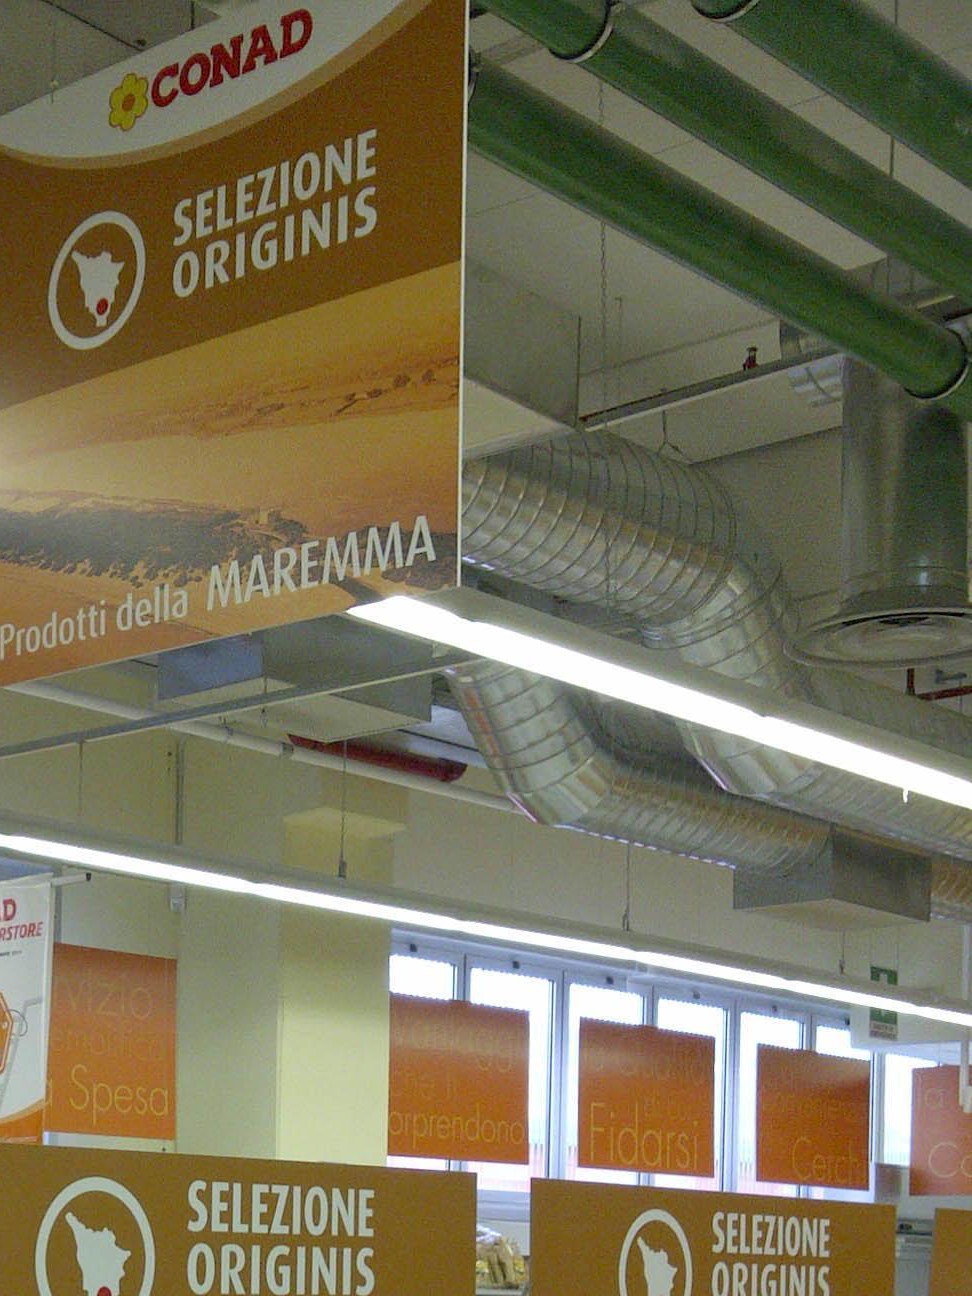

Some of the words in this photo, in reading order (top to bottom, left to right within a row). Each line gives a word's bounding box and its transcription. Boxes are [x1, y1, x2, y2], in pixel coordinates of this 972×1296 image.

[149, 7, 314, 109] CONAD
[172, 128, 379, 248] SELEZIONE
[172, 185, 379, 299] ORIGINIS
[116, 585, 189, 632] della
[206, 514, 437, 613] MAREMMA
[69, 1063, 170, 1127] Spesa
[388, 1101, 526, 1149] orprendono
[589, 1101, 700, 1171] Fidarsi
[186, 1178, 375, 1239] SELEZIONE
[711, 1210, 830, 1259] SELEZIONE
